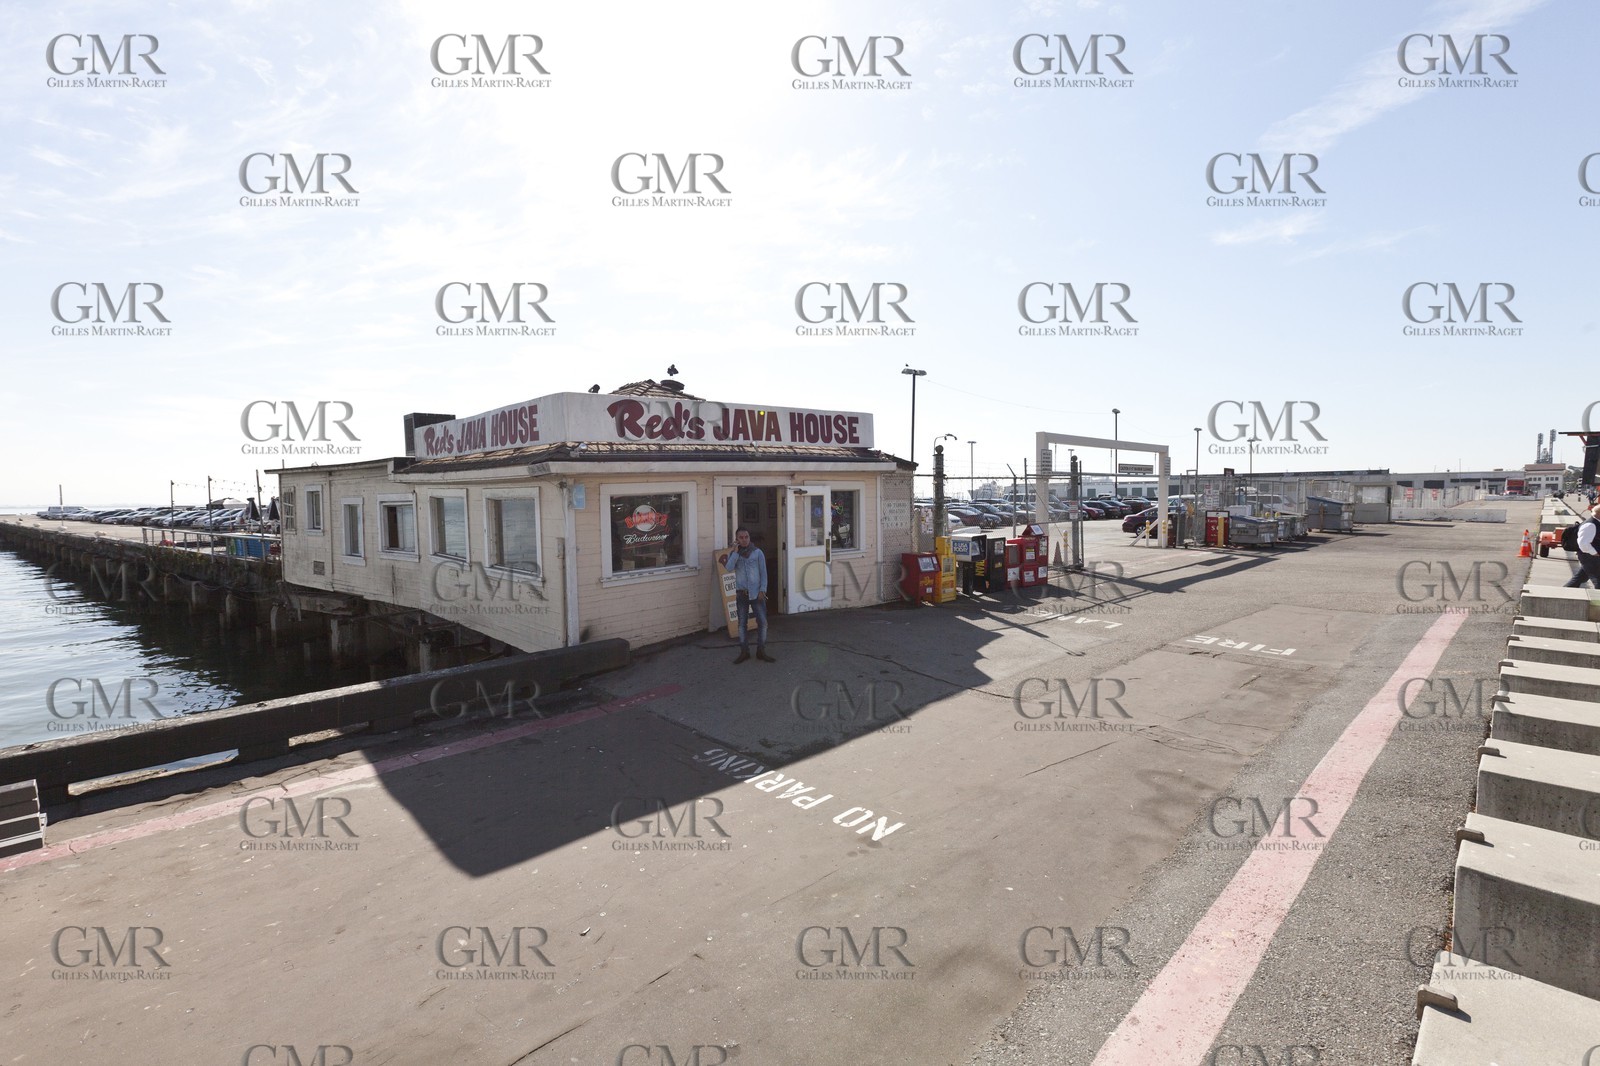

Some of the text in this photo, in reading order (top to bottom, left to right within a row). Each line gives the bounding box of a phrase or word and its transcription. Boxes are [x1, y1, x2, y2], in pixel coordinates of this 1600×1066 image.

[424, 404, 539, 456] Red's JAVA HOUSE
[606, 399, 859, 444] Red's JAVA HOUSE
[1186, 635, 1297, 656] FIRE
[695, 748, 906, 841] NO PARKING
